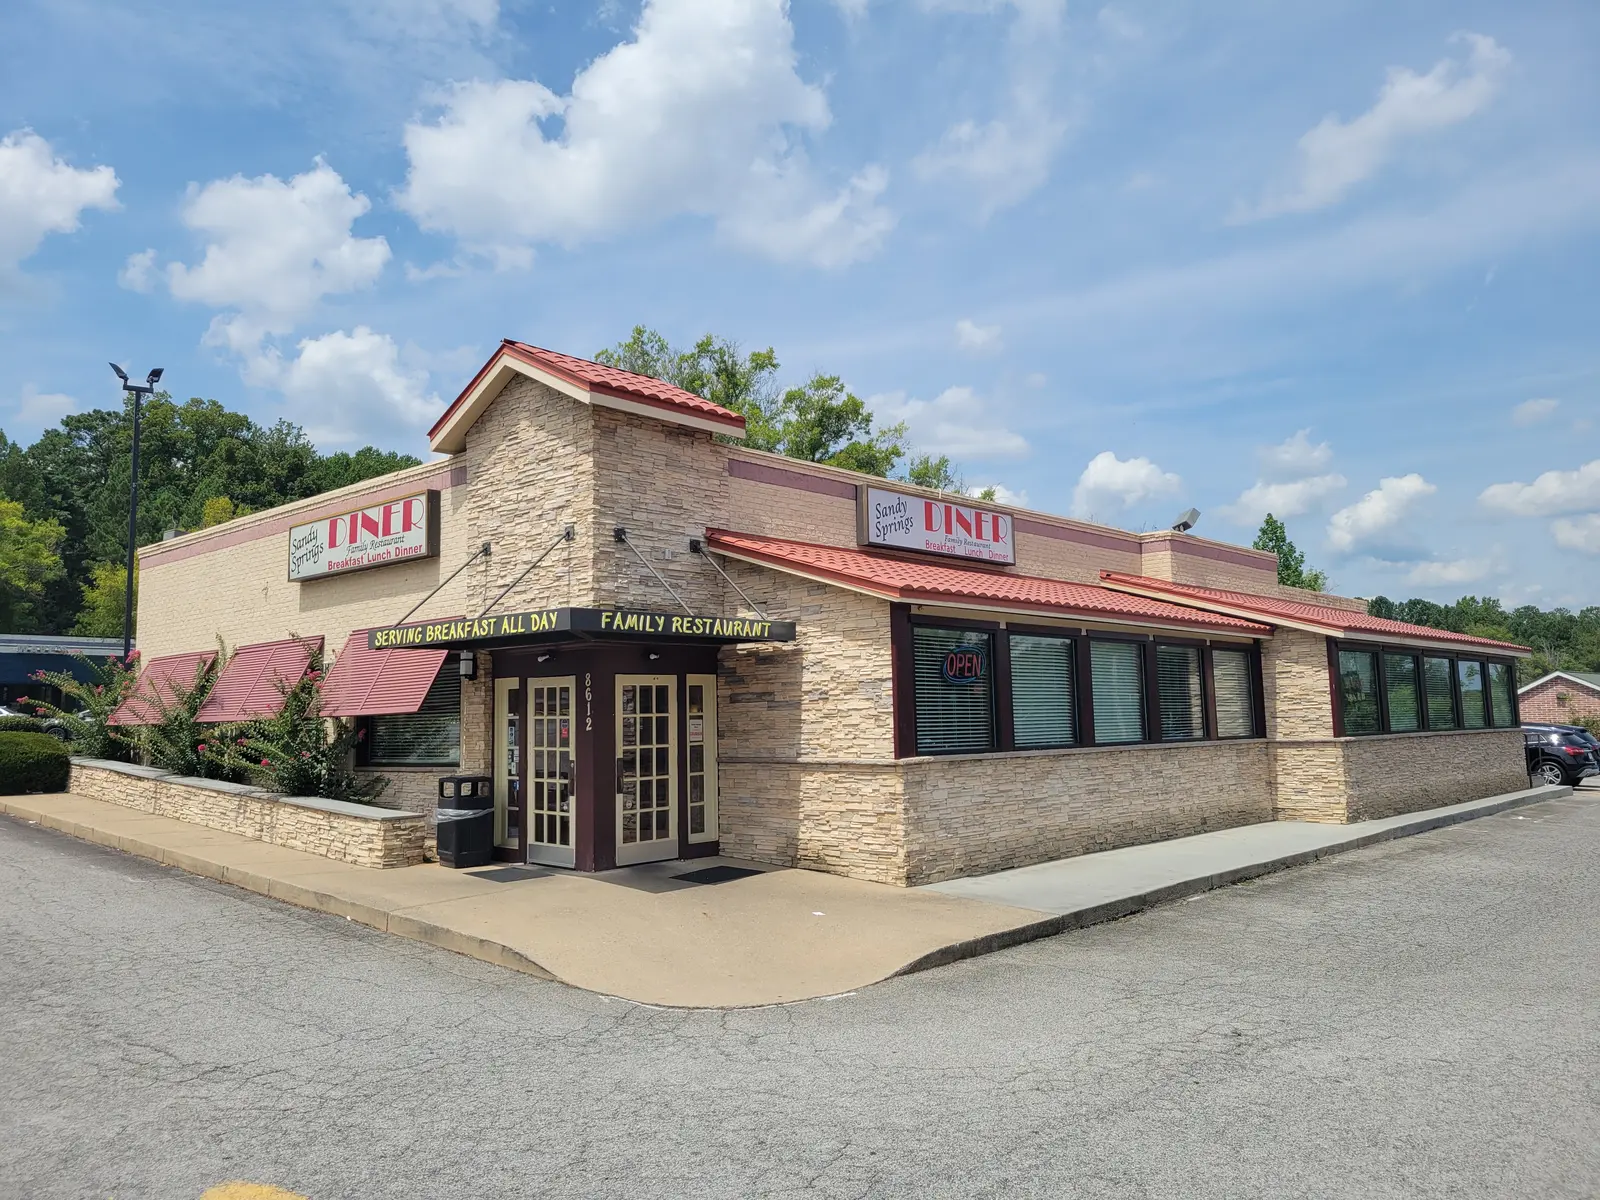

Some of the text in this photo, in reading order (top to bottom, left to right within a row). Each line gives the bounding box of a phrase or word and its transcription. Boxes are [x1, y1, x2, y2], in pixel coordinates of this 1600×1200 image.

[875, 497, 908, 520] Sandy
[328, 498, 424, 549] DINER
[875, 514, 914, 542] Springs
[924, 501, 1008, 545] DINER
[291, 525, 319, 556] Sandy
[345, 535, 405, 557] Family Restaurant
[925, 540, 1009, 562] Breakfast Lunch Dinner
[944, 535, 991, 549] Family Restaurant
[291, 542, 324, 575] Springs
[327, 544, 423, 571] Breakfast Lunch Dinner
[374, 611, 558, 647] SERVING BREAKFAST ALL DAY
[601, 611, 772, 638] FAMILY RESTAURANT
[947, 653, 981, 676] OPEN
[584, 672, 593, 732] 8612
